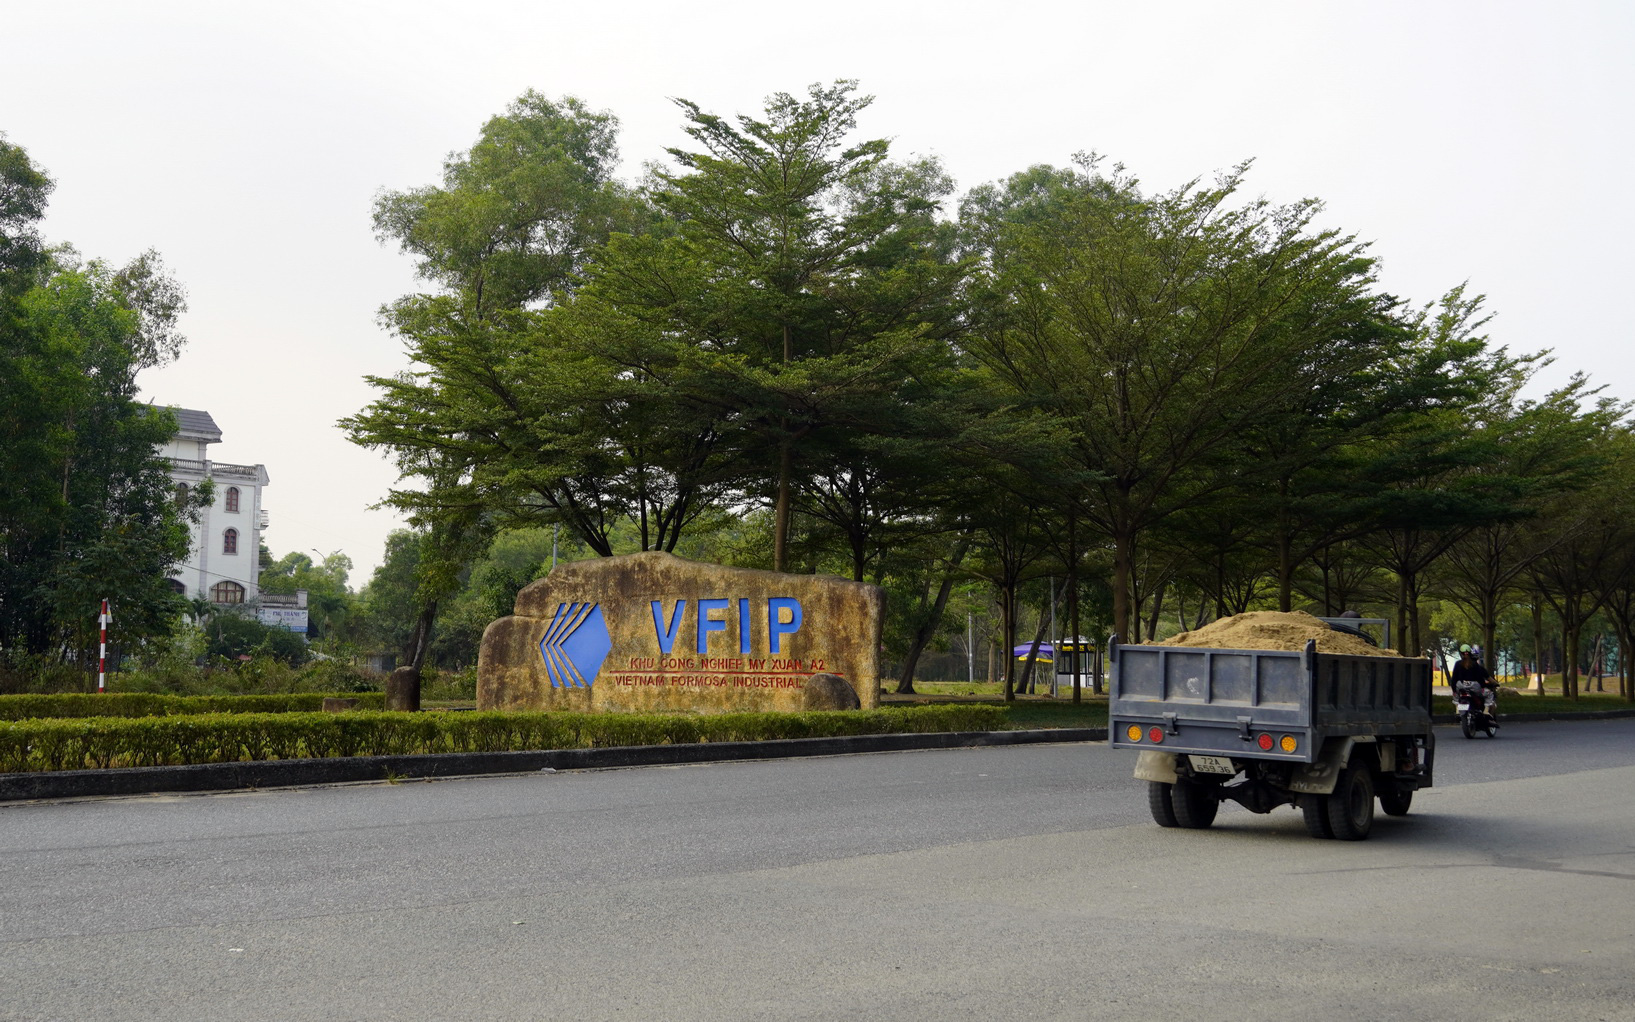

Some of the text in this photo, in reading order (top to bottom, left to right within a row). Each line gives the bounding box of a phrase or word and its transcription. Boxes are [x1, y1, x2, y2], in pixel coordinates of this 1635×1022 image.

[650, 597, 803, 654] VFIP
[630, 657, 825, 671] KHU CONG NGHIEP MY XUAN A2
[615, 675, 803, 689] VIETNAM FORMOSA INDUSTRIAL
[1200, 757, 1221, 766] 72A
[1196, 764, 1231, 774] 659.36
